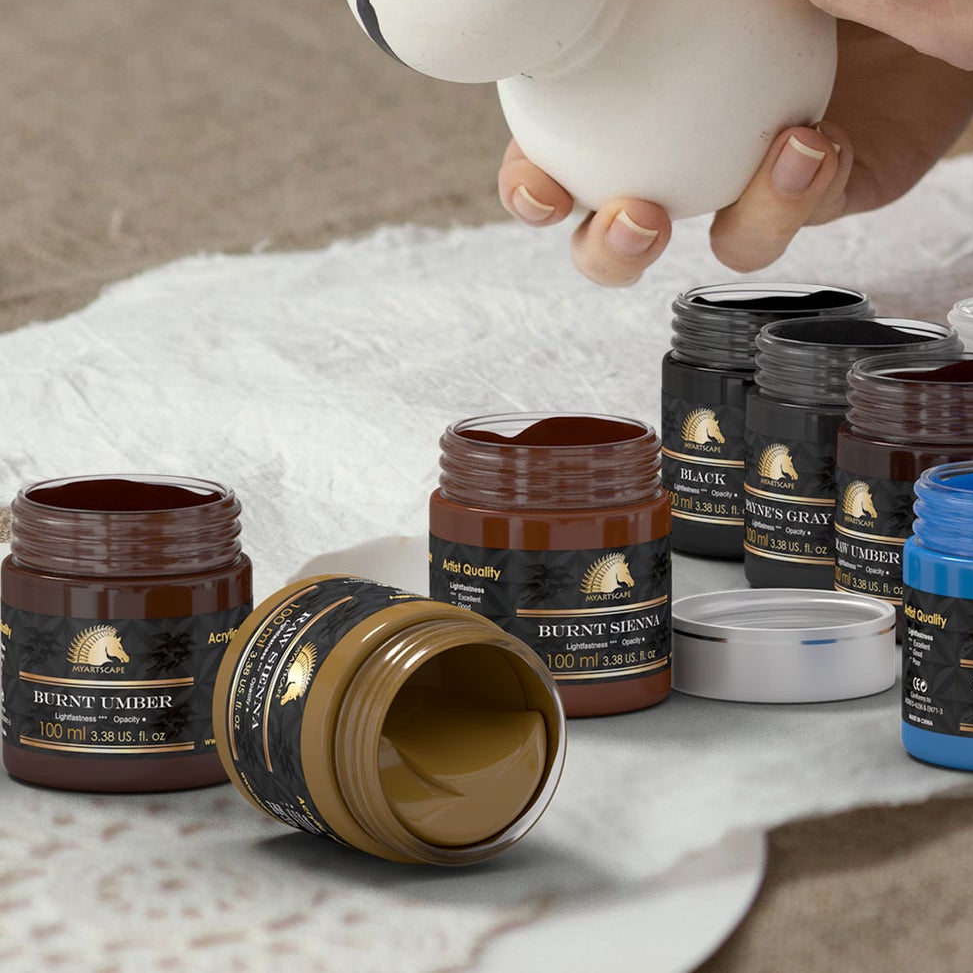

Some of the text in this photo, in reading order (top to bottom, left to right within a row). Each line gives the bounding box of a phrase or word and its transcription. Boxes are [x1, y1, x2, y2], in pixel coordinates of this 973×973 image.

[680, 468, 727, 485] BLACK
[668, 491, 679, 507] 00
[681, 496, 693, 510] ml
[695, 501, 712, 513] 3.38
[714, 504, 729, 514] US.
[731, 505, 740, 515] fl.
[711, 489, 733, 499] Opacity
[745, 498, 784, 520] PAYNE'S
[787, 510, 833, 525] GRAY
[785, 526, 807, 537] Opacity
[757, 533, 769, 547] ml
[770, 538, 786, 551] 3.38
[788, 541, 802, 552] US.
[804, 542, 813, 553] fl.
[815, 546, 828, 554] oz
[835, 538, 901, 565] RAW UMBER
[442, 558, 501, 581] Artist Quality
[865, 566, 885, 576] Opacity
[449, 582, 485, 594] Lightfastness
[841, 570, 851, 585] ml
[852, 577, 867, 590] 3.38
[868, 581, 881, 592] US.
[883, 583, 891, 594] fl.
[893, 586, 904, 595] oz
[458, 593, 482, 604] Excellent
[585, 591, 632, 602] MYARTSCAPE
[273, 603, 301, 626] 100
[904, 604, 947, 629] Artist Quality
[537, 615, 661, 639] BURNT SIENNA
[255, 628, 273, 651] ml
[566, 637, 641, 651] Lightfastness Opacity
[71, 665, 126, 675] MYARTSCAPE
[242, 650, 258, 676] 3.38
[546, 654, 575, 669] 100
[579, 652, 599, 668] ml
[602, 655, 623, 667] 3.38
[625, 653, 638, 664] US.
[648, 650, 656, 659] oz
[251, 611, 313, 730] RAW SIENNA
[237, 679, 247, 698] US.
[245, 677, 257, 706] Opacity
[32, 690, 174, 711] BURNT UMBER
[54, 712, 141, 726] Lightfastness Opacity
[233, 715, 241, 730] oz
[39, 721, 166, 743] 100 ml 3.38 US. fl. oz
